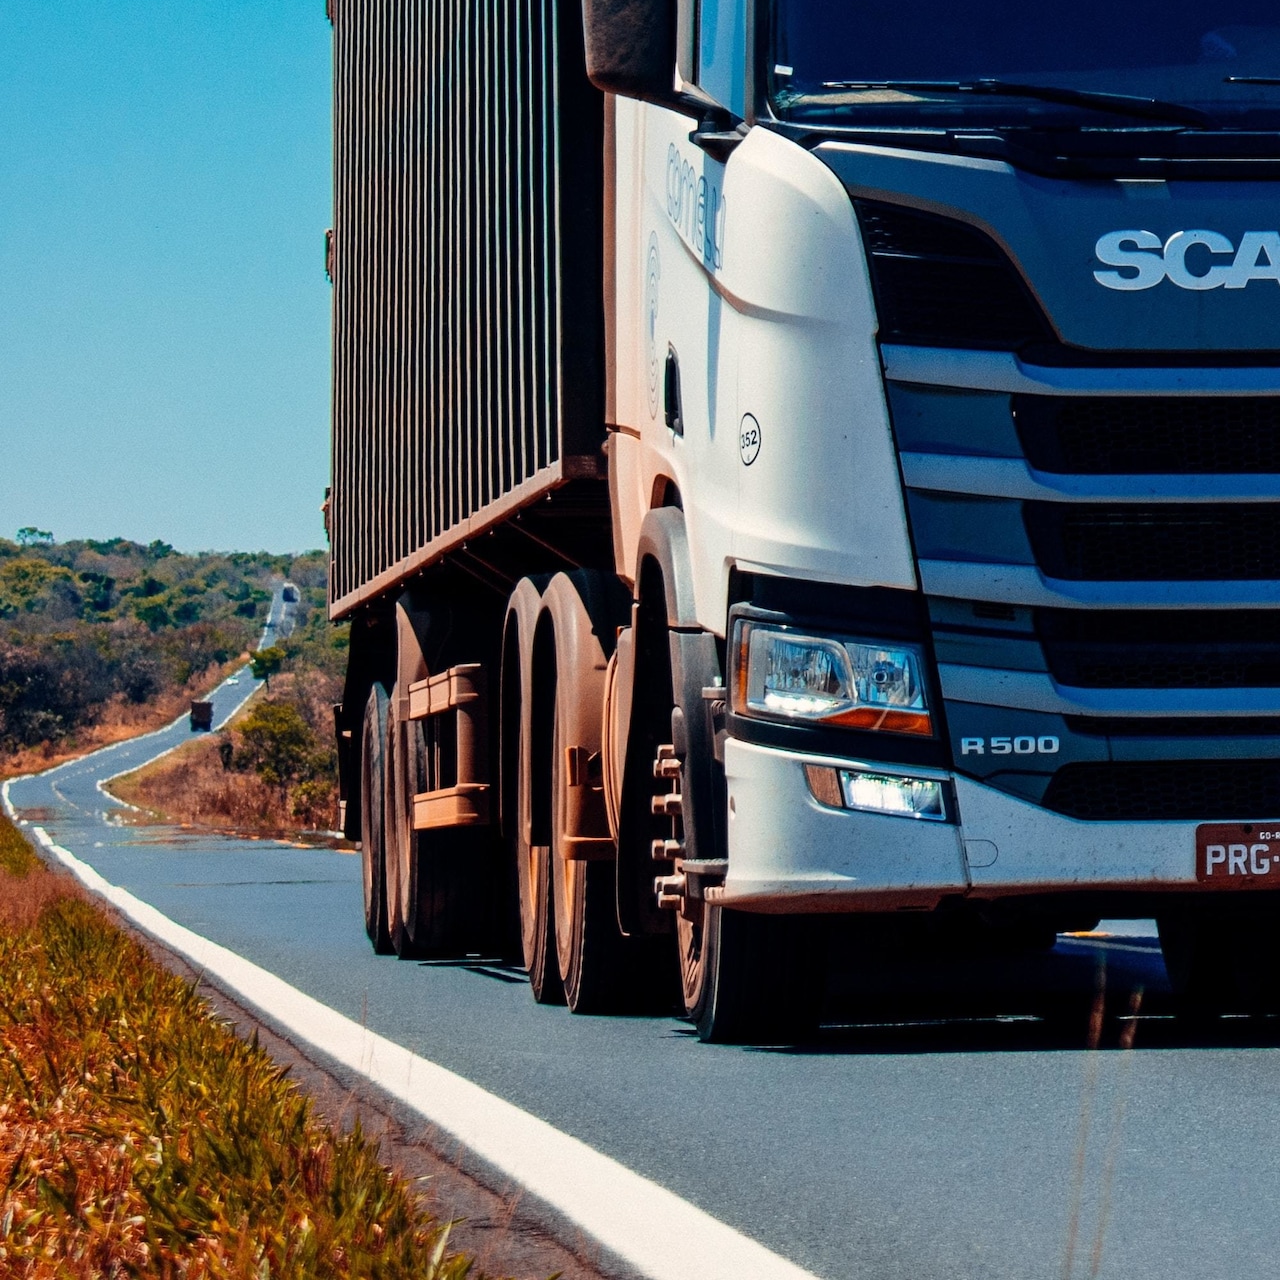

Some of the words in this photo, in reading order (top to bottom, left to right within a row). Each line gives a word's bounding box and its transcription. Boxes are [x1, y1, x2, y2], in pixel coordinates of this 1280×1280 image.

[741, 429, 758, 449] 352
[961, 737, 985, 754] R
[991, 735, 1060, 754] 500
